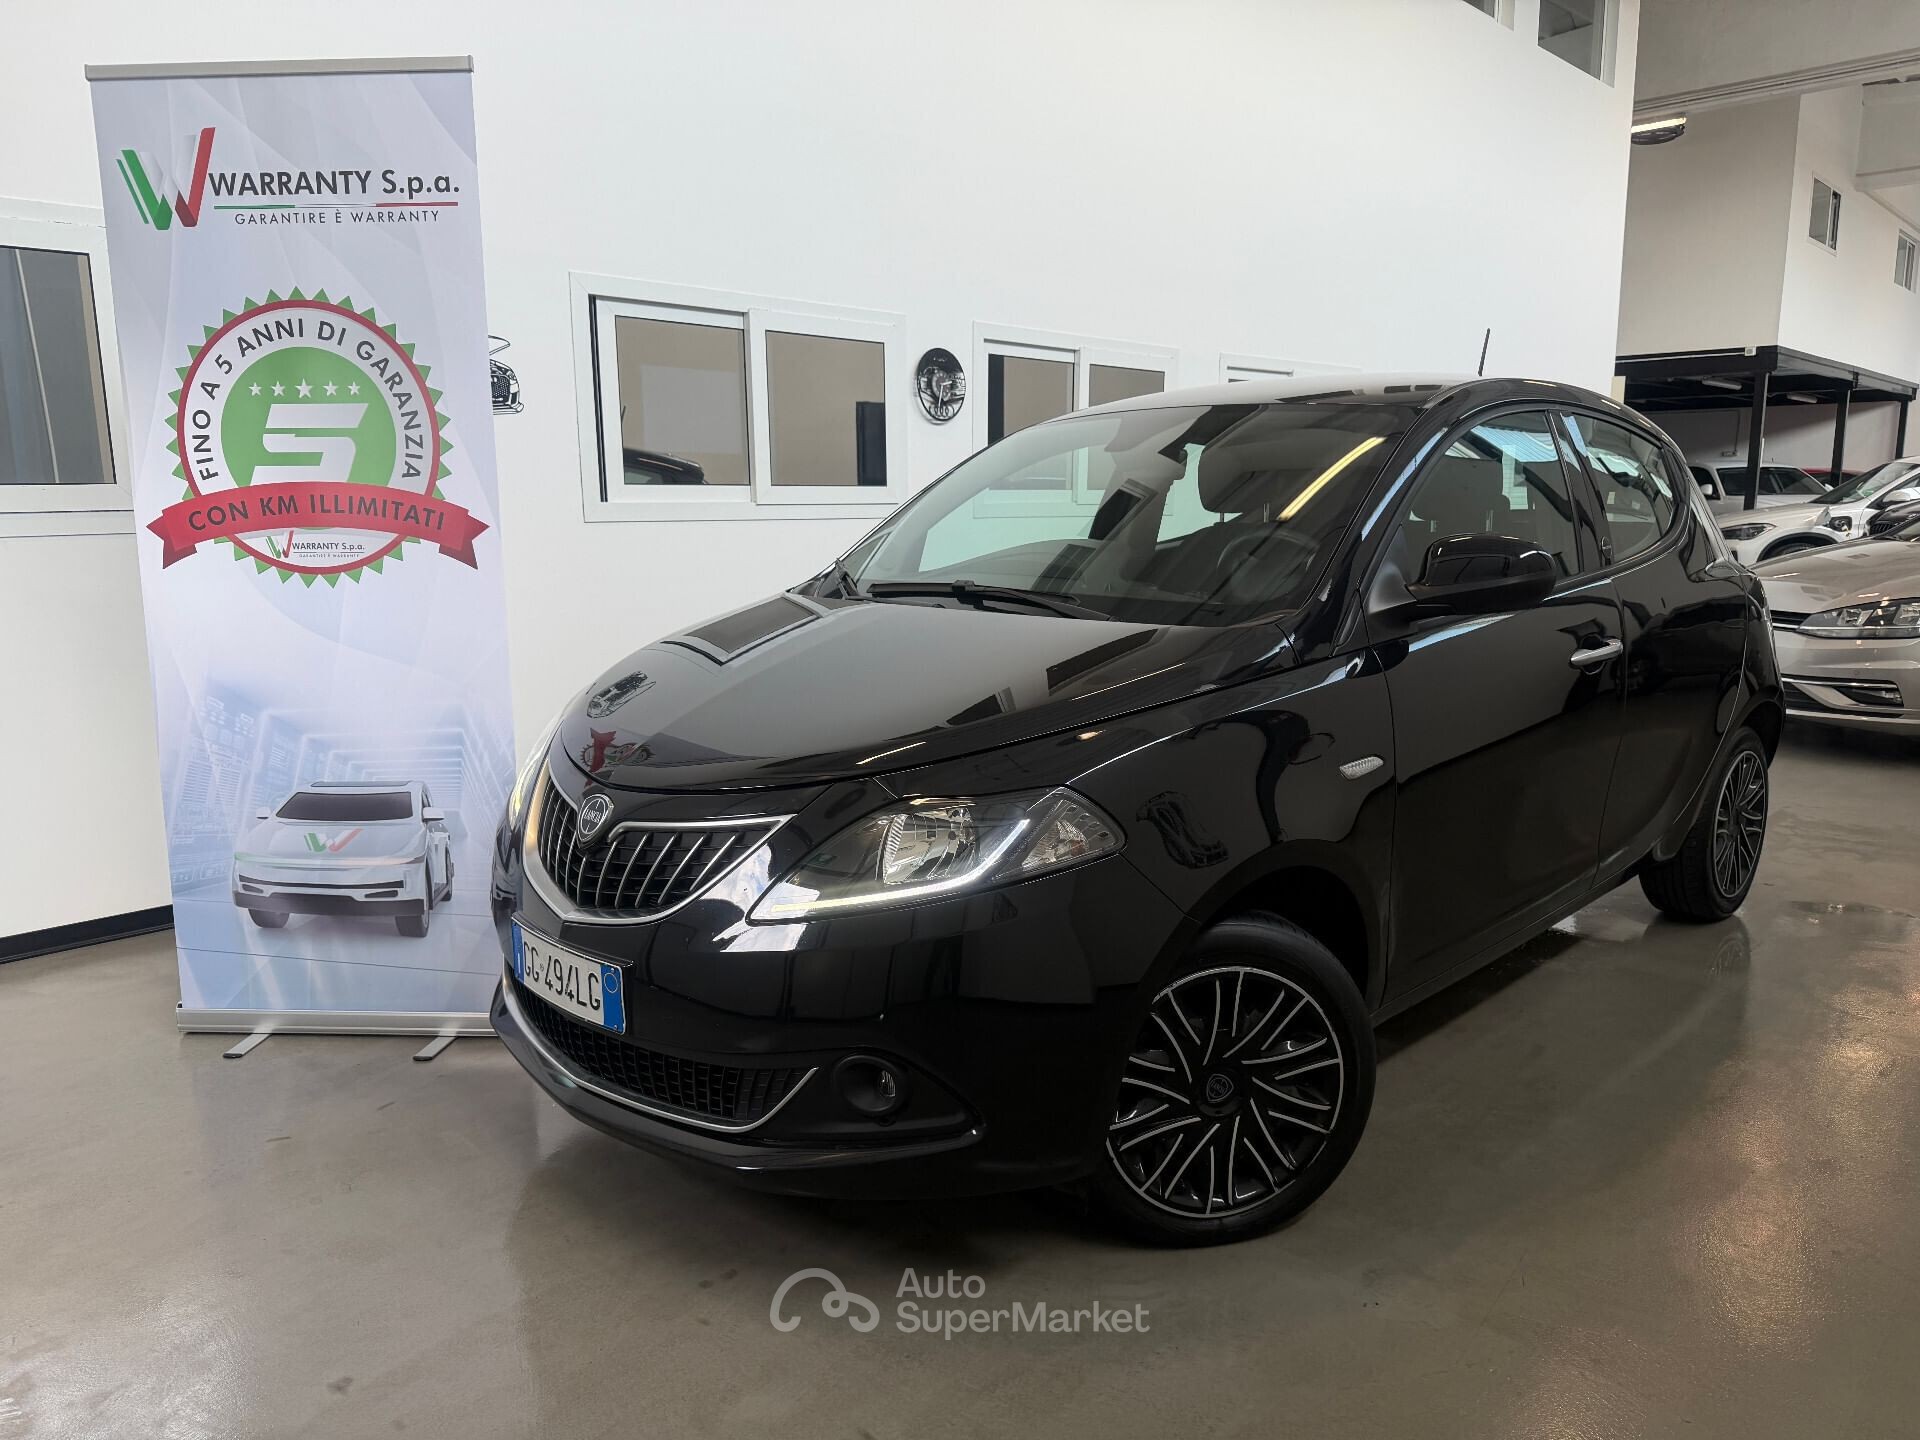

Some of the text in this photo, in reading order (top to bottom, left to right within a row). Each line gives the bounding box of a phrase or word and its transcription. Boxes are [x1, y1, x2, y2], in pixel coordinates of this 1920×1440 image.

[209, 170, 460, 200] WARRANTY S.p.a.
[234, 209, 441, 226] GARANTIRE È WARRANTY
[191, 317, 424, 481] FINO A 5 ANNI DI GARANZIA
[188, 493, 446, 532] CON KM ILLIMITATI
[292, 542, 365, 551] WARRANTY S.p.a.
[523, 941, 601, 1011] GG 494LG
